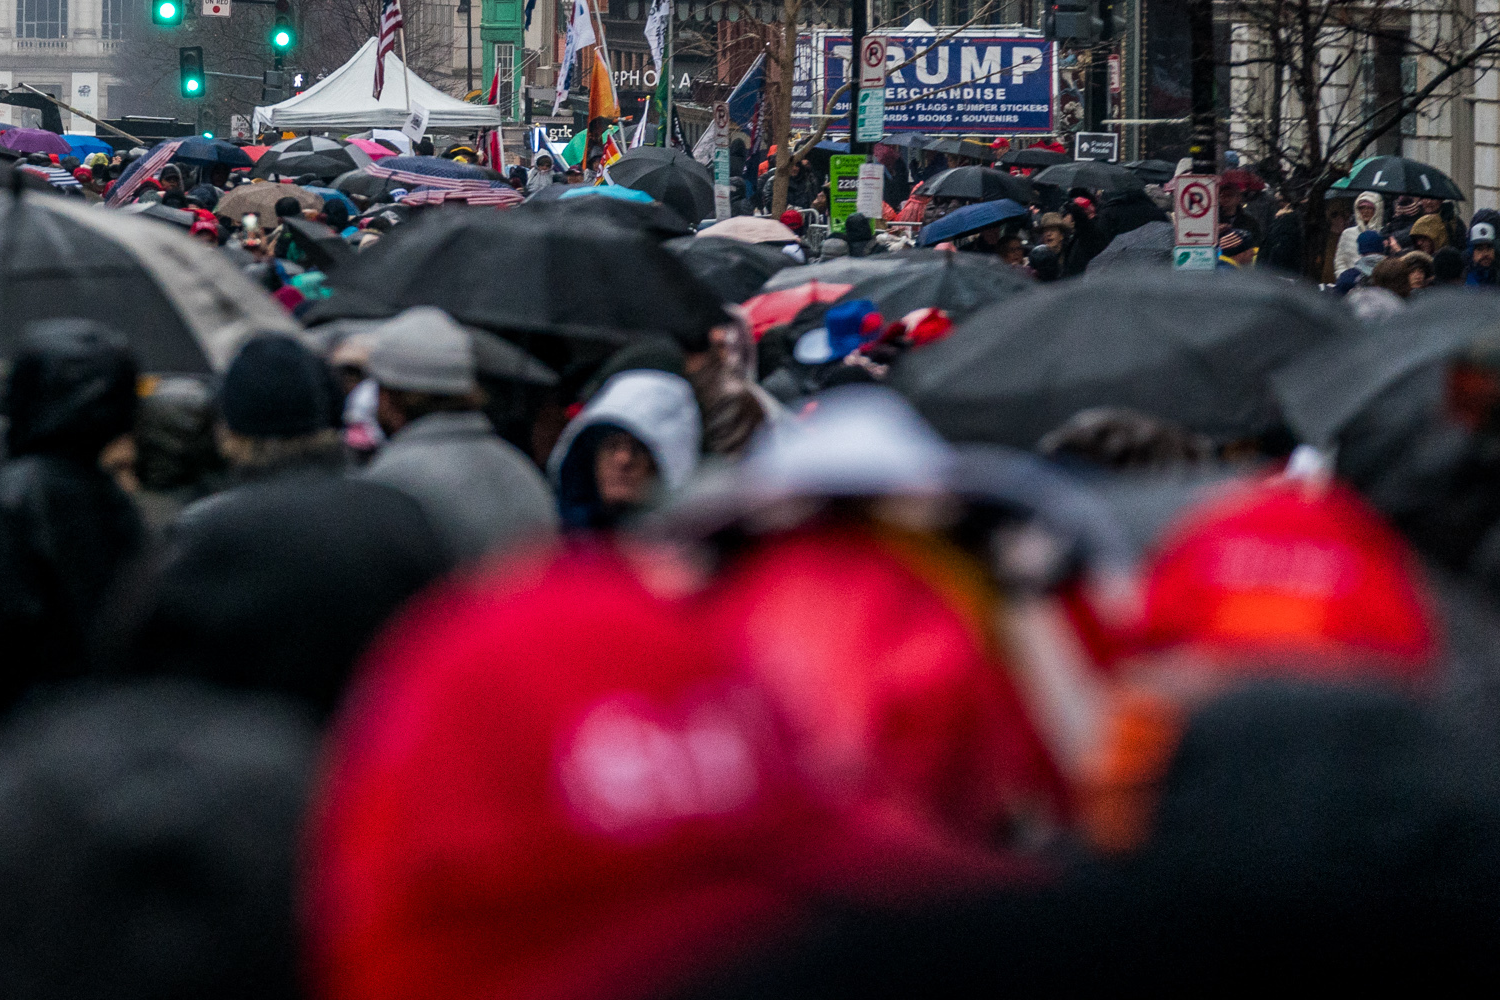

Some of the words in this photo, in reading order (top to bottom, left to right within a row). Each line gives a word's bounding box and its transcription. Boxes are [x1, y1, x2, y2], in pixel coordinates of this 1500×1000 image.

[833, 45, 1043, 85] TRUMP
[885, 87, 1006, 99] ERCHANDISE
[915, 103, 948, 111] FLAGS
[957, 103, 998, 111] BUMPER
[1000, 104, 1049, 112] STICKERS
[917, 114, 953, 122] BOOKS
[549, 125, 573, 141] grk
